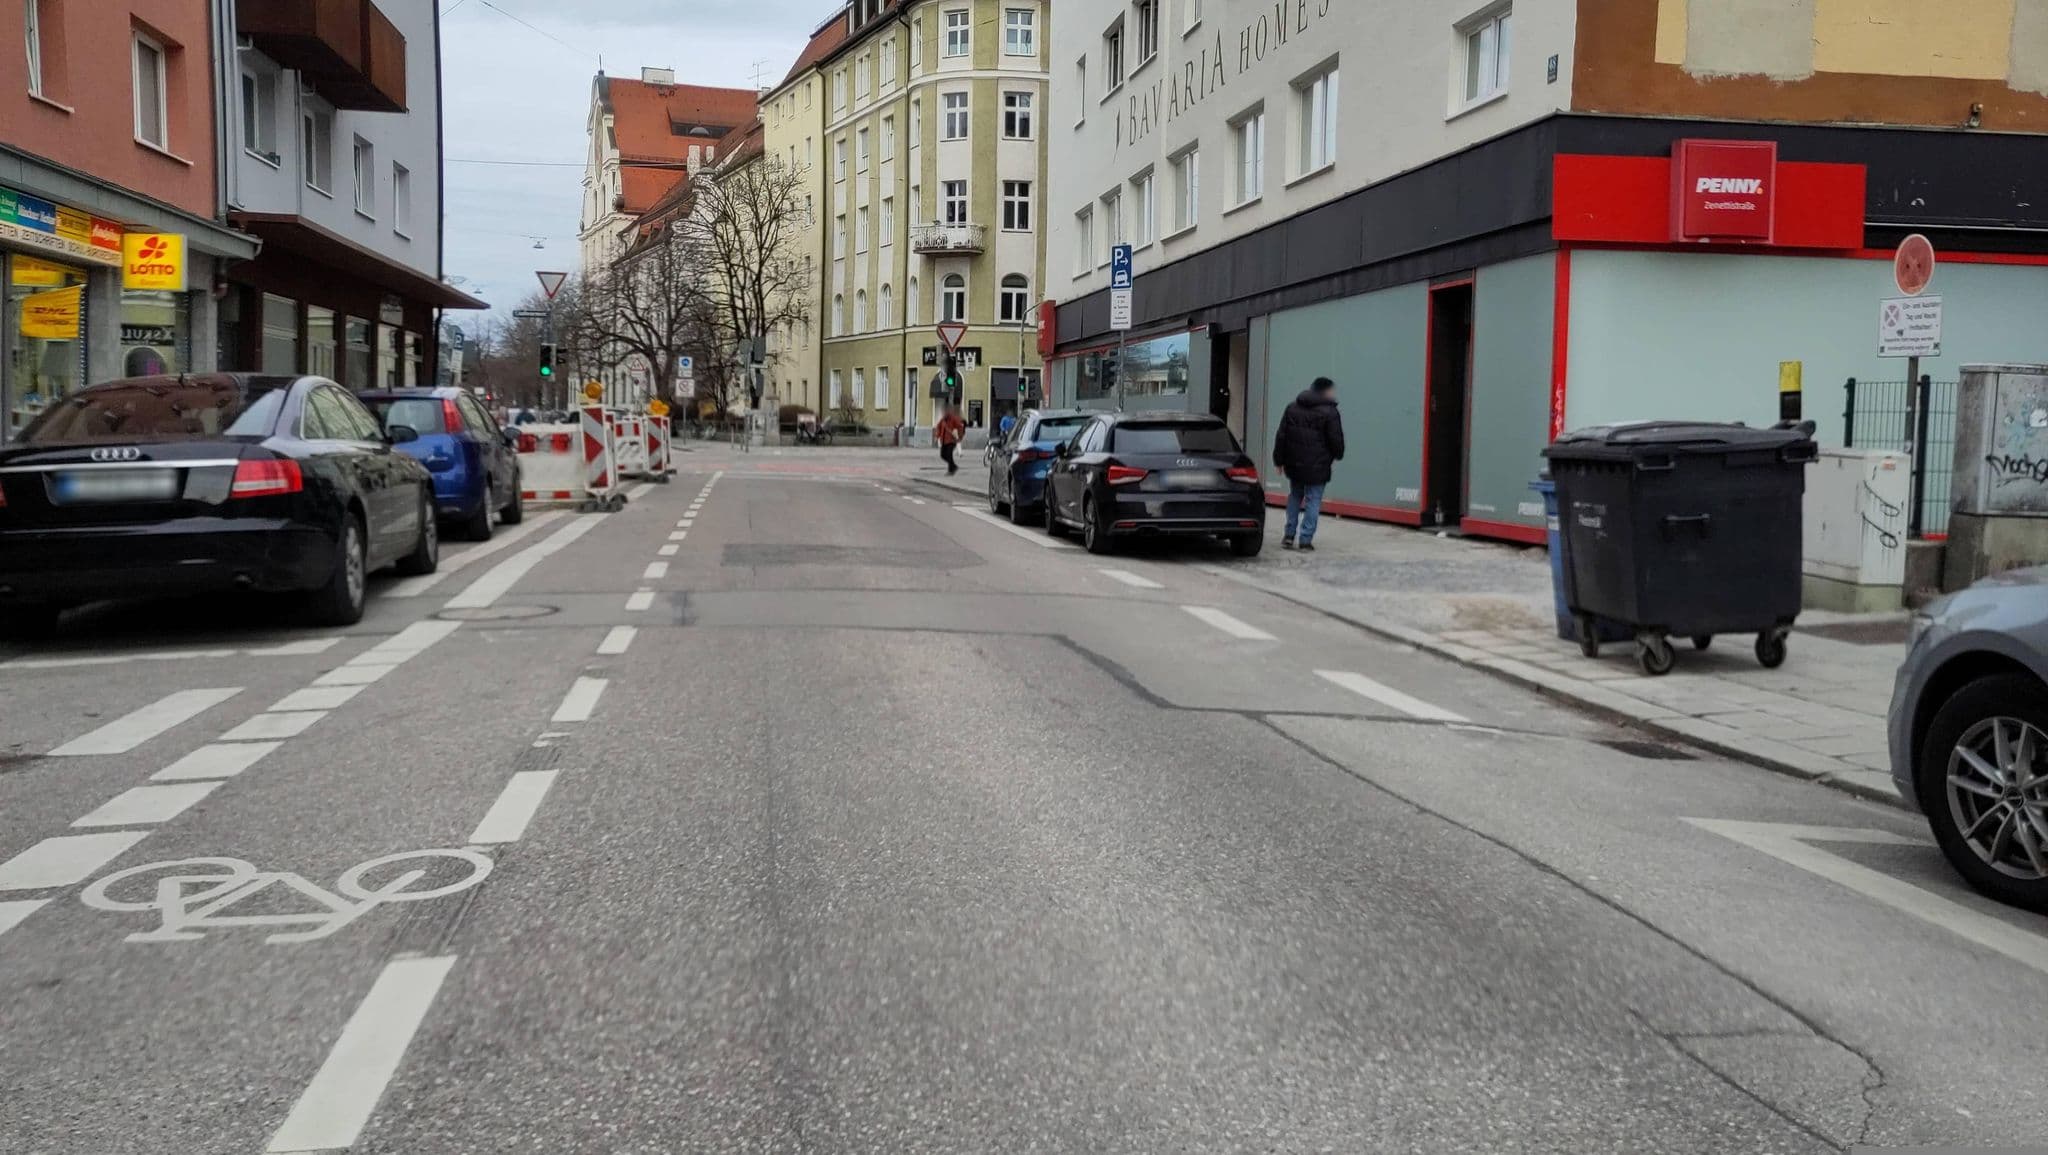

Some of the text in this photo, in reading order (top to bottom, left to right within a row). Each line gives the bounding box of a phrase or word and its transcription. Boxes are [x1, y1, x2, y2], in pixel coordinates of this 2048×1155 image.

[1129, 28, 1225, 146] BAVARIA
[1114, 248, 1124, 266] P
[130, 264, 175, 275] LOTTO
